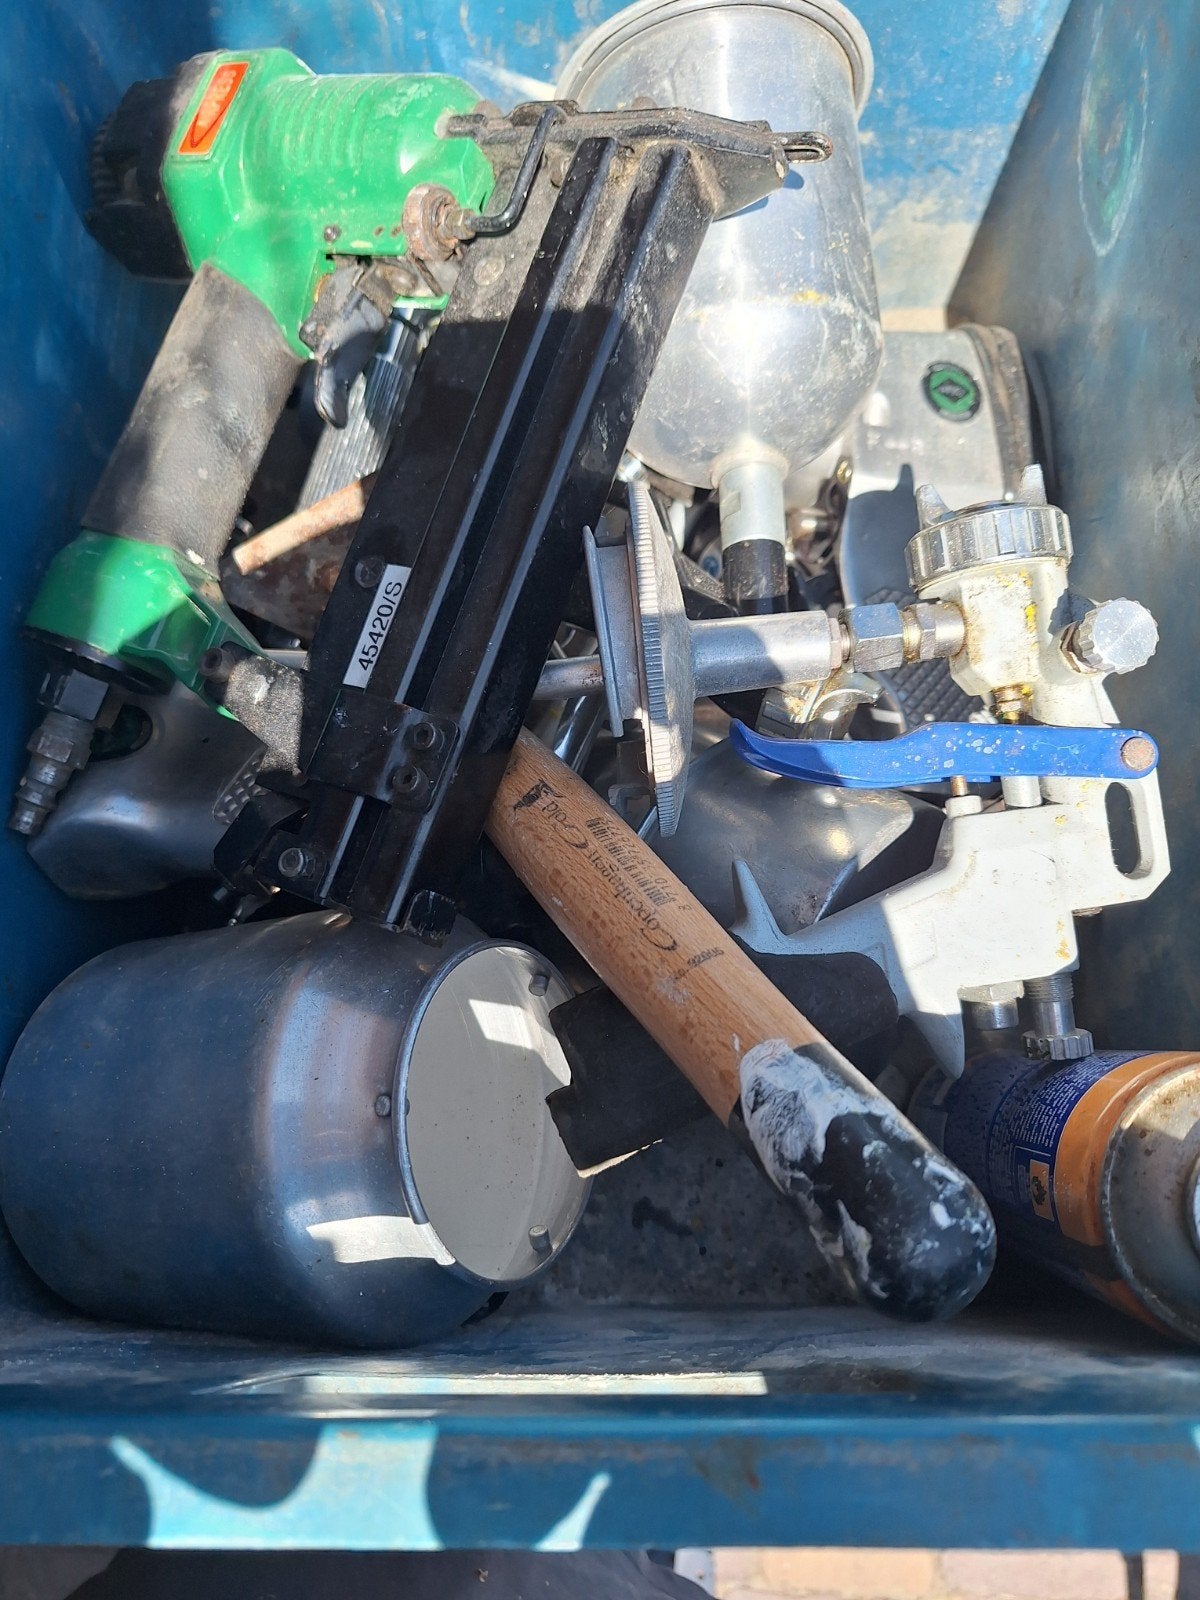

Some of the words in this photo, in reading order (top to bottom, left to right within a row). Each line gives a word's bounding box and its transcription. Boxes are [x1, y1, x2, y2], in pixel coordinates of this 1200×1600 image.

[358, 581, 402, 671] 45420/S
[541, 800, 589, 849] Gold
[587, 850, 678, 951] Copenhagen
